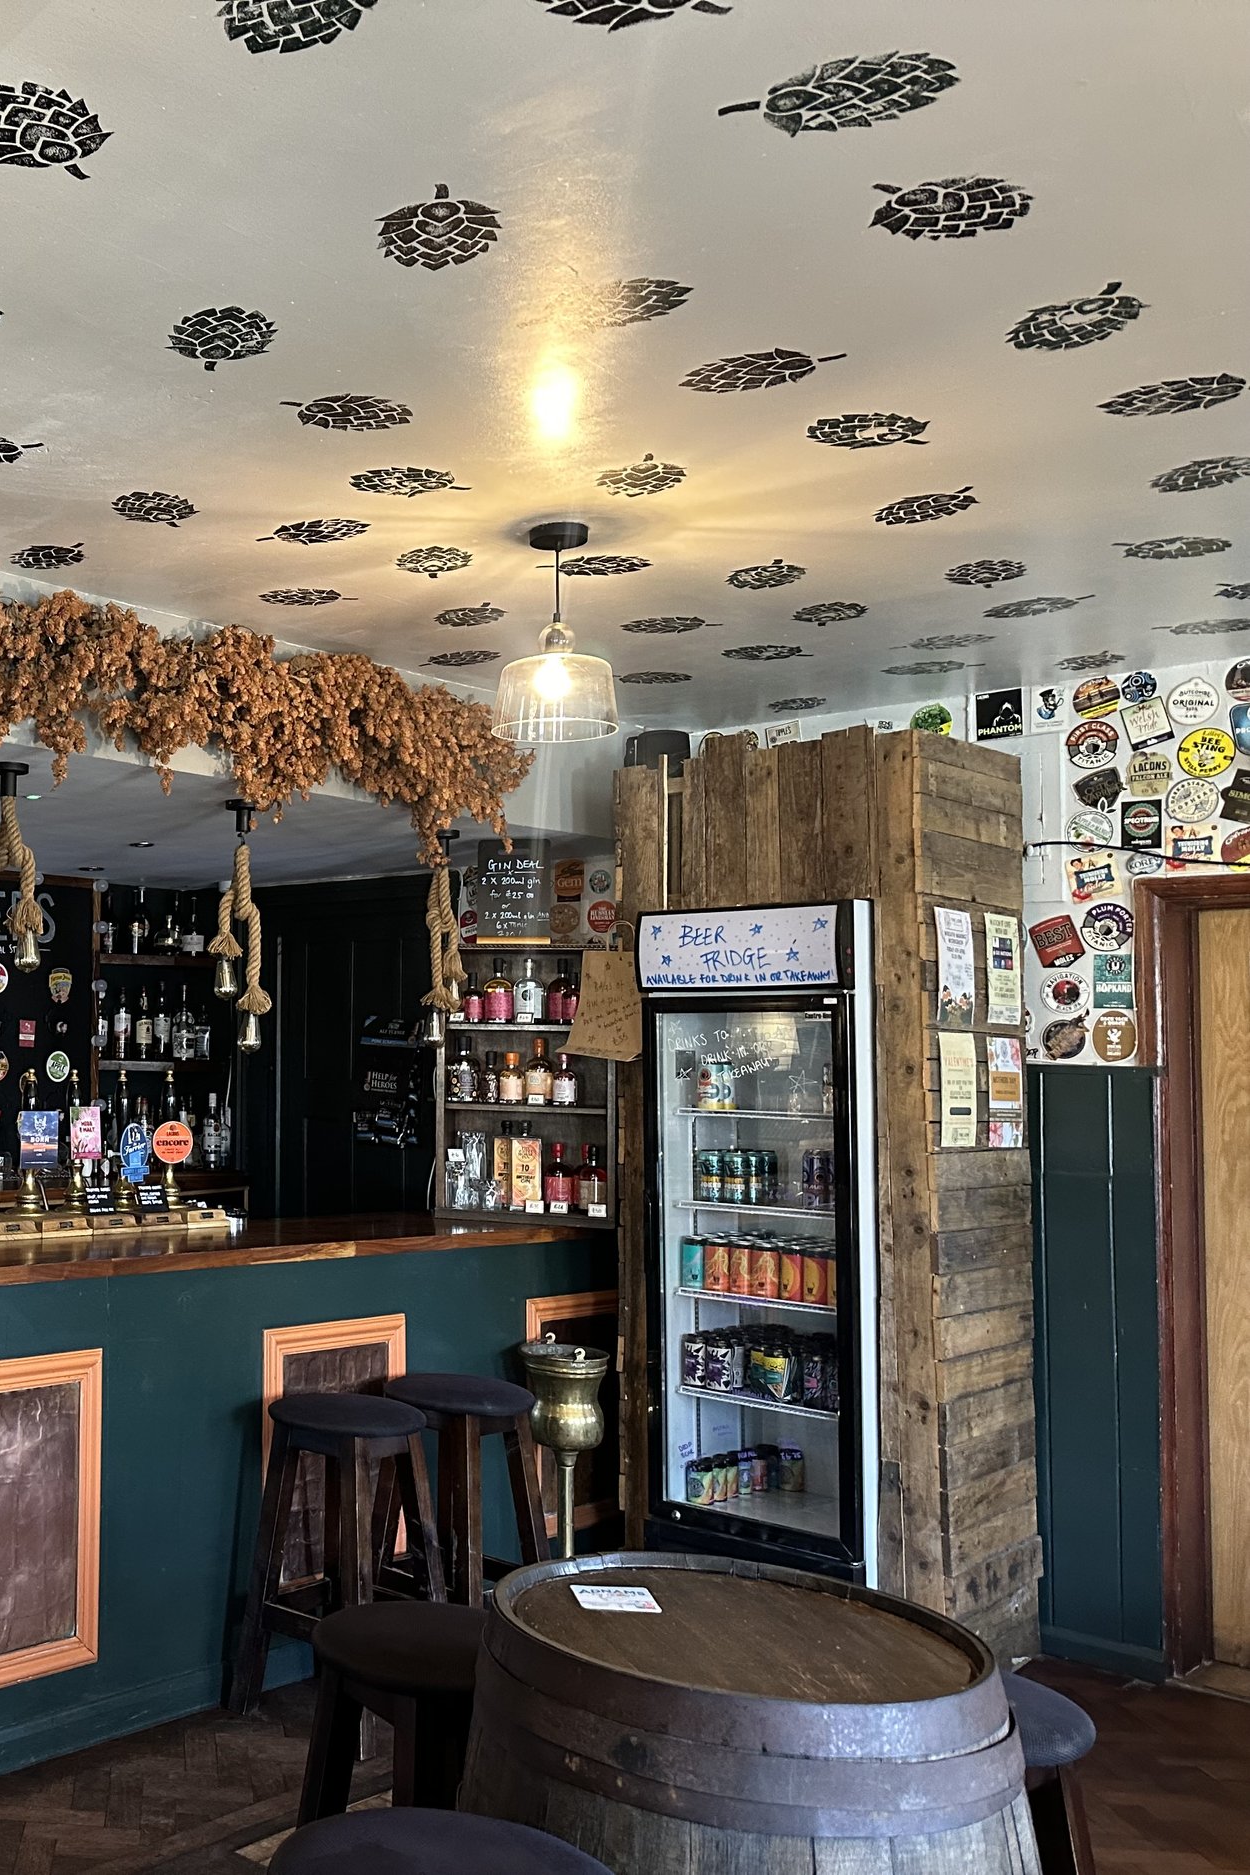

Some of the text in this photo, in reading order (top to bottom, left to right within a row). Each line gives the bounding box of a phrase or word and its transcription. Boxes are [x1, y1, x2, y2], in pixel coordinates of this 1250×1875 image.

[1172, 700, 1214, 708] ORIGINAL
[1130, 709, 1160, 725] Welsh
[978, 724, 1022, 736] PHANTOM
[1070, 723, 1114, 741] FIRST CLASS
[1201, 736, 1222, 745] BEE
[1192, 742, 1226, 753] STING
[1077, 754, 1110, 765] TITANIC
[1133, 761, 1166, 773] LACONS
[1171, 788, 1214, 814] HOPHEAD
[1229, 790, 1250, 800] SIMO
[488, 859, 544, 870] GIN DEAL
[527, 878, 541, 889] gin
[557, 879, 582, 888] Gem
[490, 891, 500, 900] for
[1092, 905, 1134, 932] PLUM PORTER
[679, 925, 726, 948] BEER
[1034, 923, 1072, 948] BEST
[1086, 930, 1114, 946] TITANIC
[700, 946, 771, 972] FRIDGE
[1054, 954, 1074, 966] MOLES
[646, 973, 696, 986] AVAILABLE
[700, 974, 718, 983] FOR
[722, 973, 750, 983] DRINK
[755, 972, 766, 982] IN
[770, 972, 782, 982] OR
[1046, 974, 1083, 988] NAVIGATION
[667, 1034, 708, 1051] DRINKS
[700, 1050, 730, 1066] DRINK
[51, 1060, 65, 1072] APPLE
[372, 1072, 398, 1082] HELP for
[372, 1080, 398, 1090] HEROES
[124, 1142, 146, 1156] Farrier
